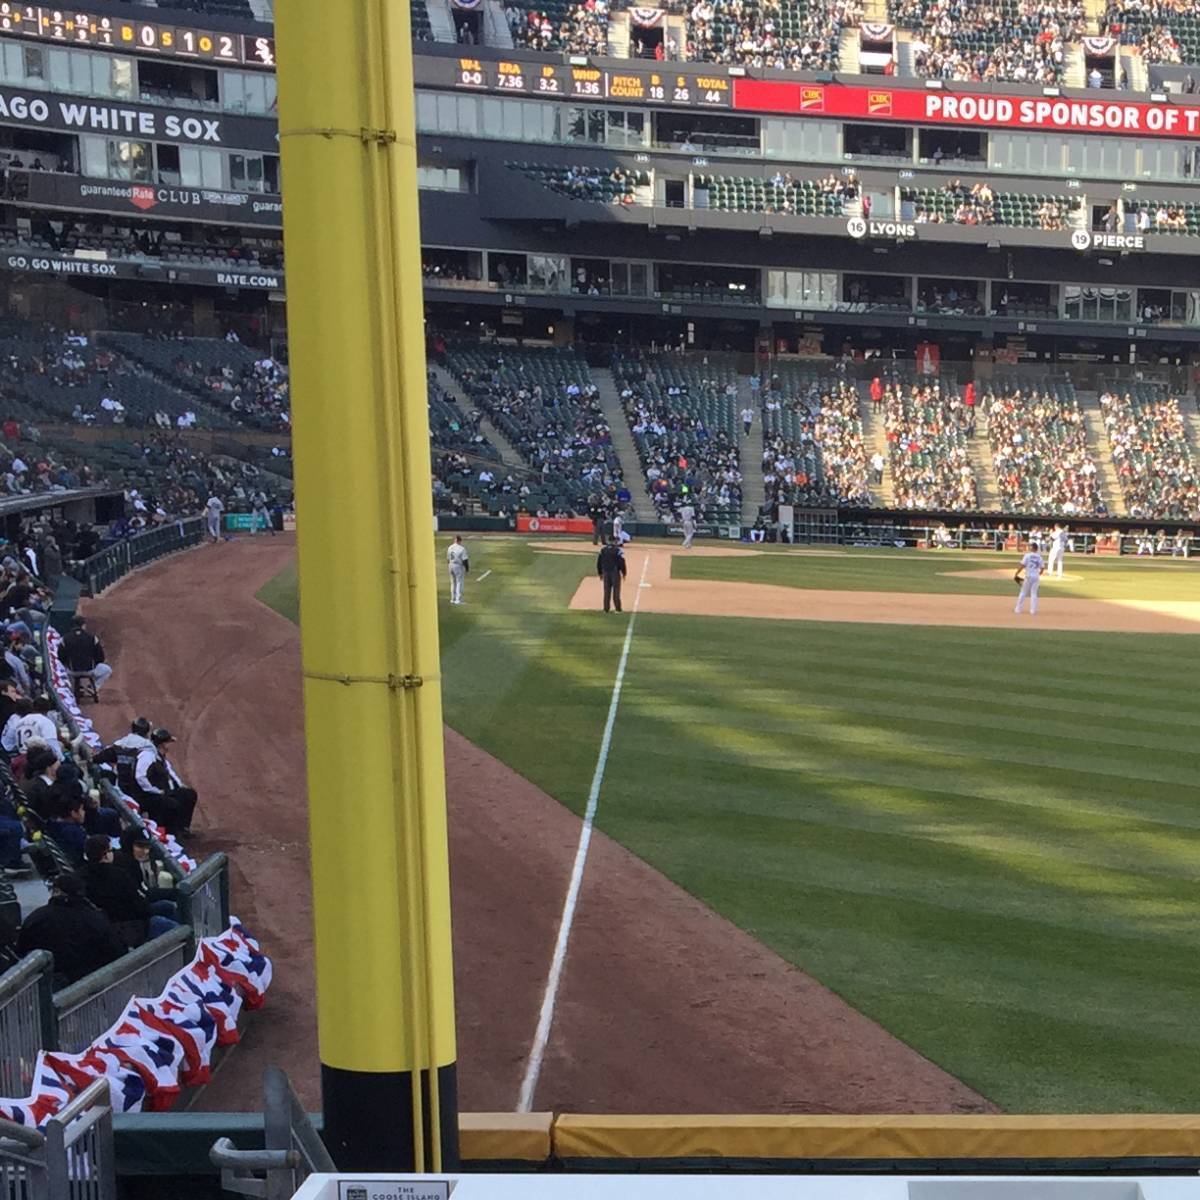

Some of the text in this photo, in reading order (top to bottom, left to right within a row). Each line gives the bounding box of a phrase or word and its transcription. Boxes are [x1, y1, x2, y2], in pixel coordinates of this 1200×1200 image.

[75, 14, 88, 25] 12
[101, 18, 110, 28] 0
[55, 26, 62, 36] 2
[103, 33, 110, 43] 1
[141, 26, 155, 46] 0
[162, 32, 172, 46] S
[184, 32, 193, 51] 1
[220, 37, 233, 56] 2
[461, 59, 601, 81] W-L ERA IP WHIP
[462, 72, 599, 94] 0-0 7.36 3.2 1.36
[613, 76, 641, 87] PITCH
[697, 78, 728, 90] TOTAL
[610, 86, 720, 102] COUNT 18 26 44
[926, 95, 1013, 121] PROUD
[1020, 100, 1139, 129] SPONSOR
[1146, 107, 1179, 129] OF
[59, 102, 156, 134] WHITE
[165, 115, 221, 142] SOX
[80, 184, 132, 199] guaranteed
[157, 189, 200, 204] CLUB
[851, 222, 915, 237] 16 LYONS
[1075, 234, 1143, 248] 19 PIERCE
[8, 257, 117, 275] GO, GO WHITE SOX
[217, 273, 278, 288] RATE.COM
